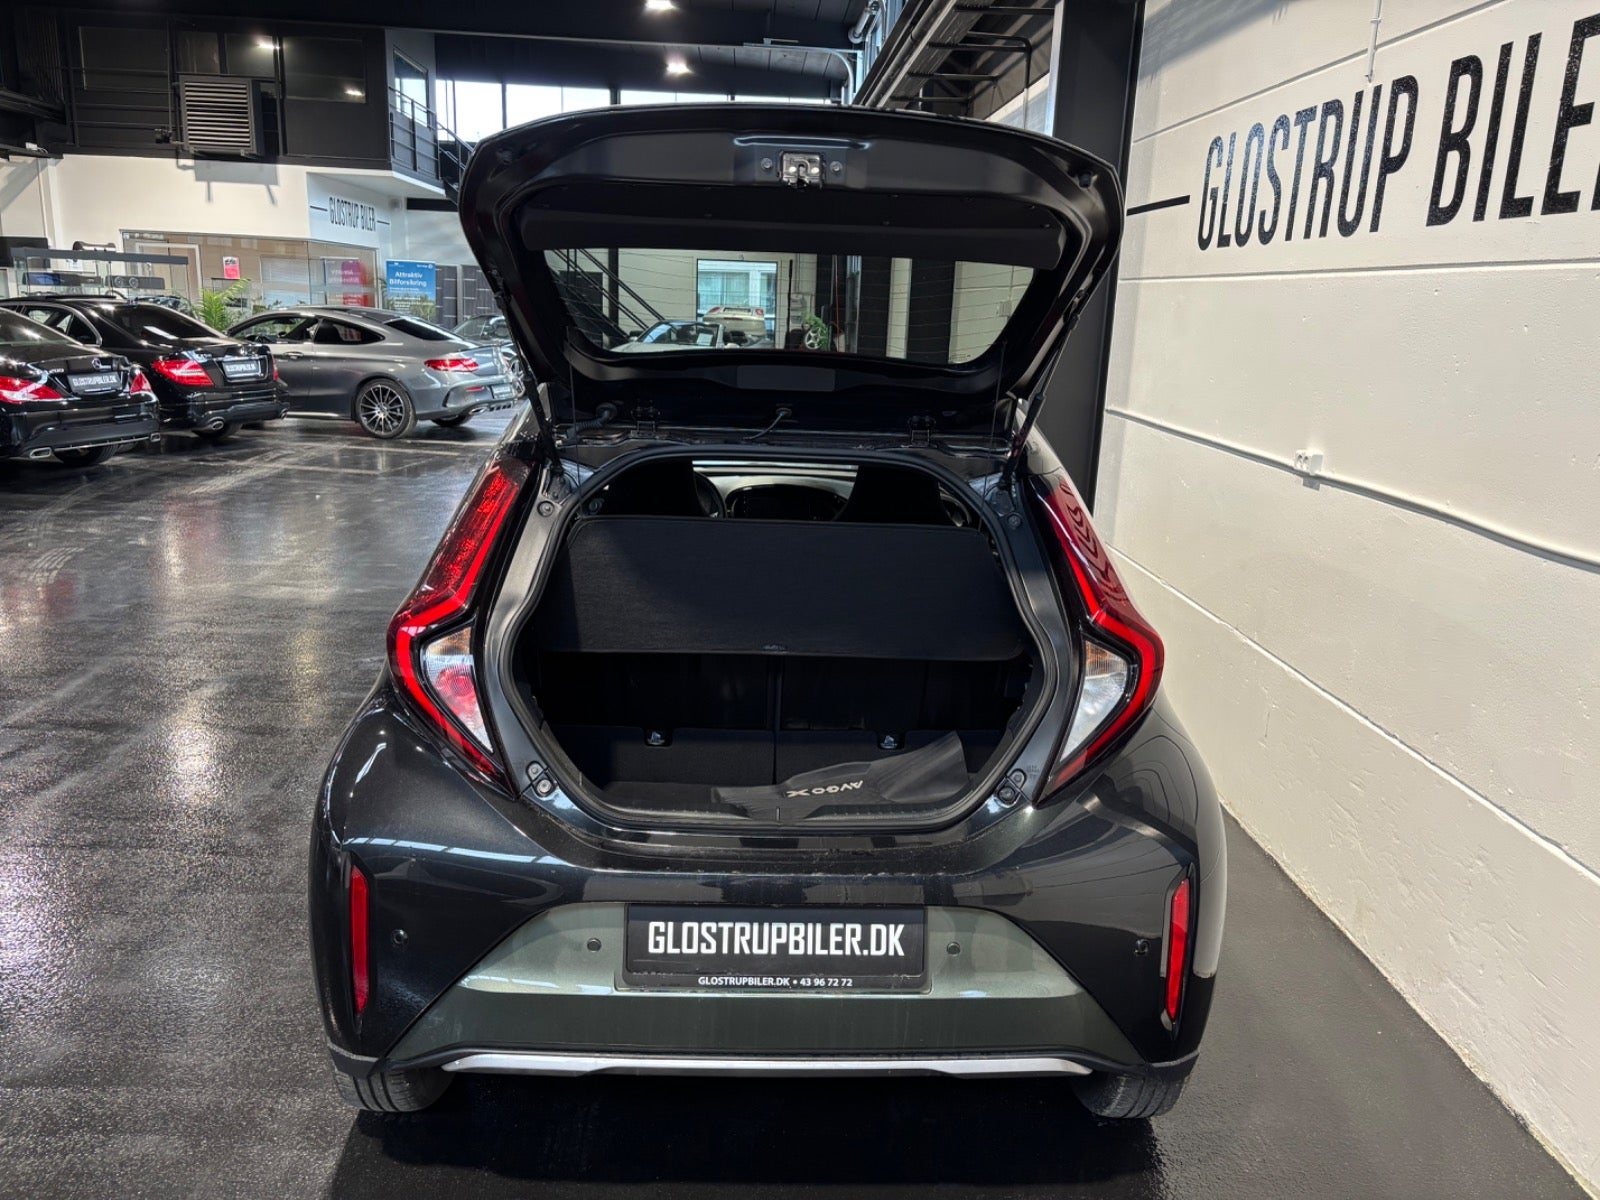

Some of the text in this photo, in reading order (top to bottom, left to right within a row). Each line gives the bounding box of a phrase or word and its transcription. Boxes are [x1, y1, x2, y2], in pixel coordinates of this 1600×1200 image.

[1197, 13, 1600, 251] GLOSTRUP BILE
[329, 196, 376, 232] GLOSTRUP BILER
[395, 271, 423, 279] Attraktiv
[648, 921, 905, 957] GLOSTRUPBILER.DK
[698, 976, 853, 987] GLOSTRUPBILER.DK 43 96 72 72
